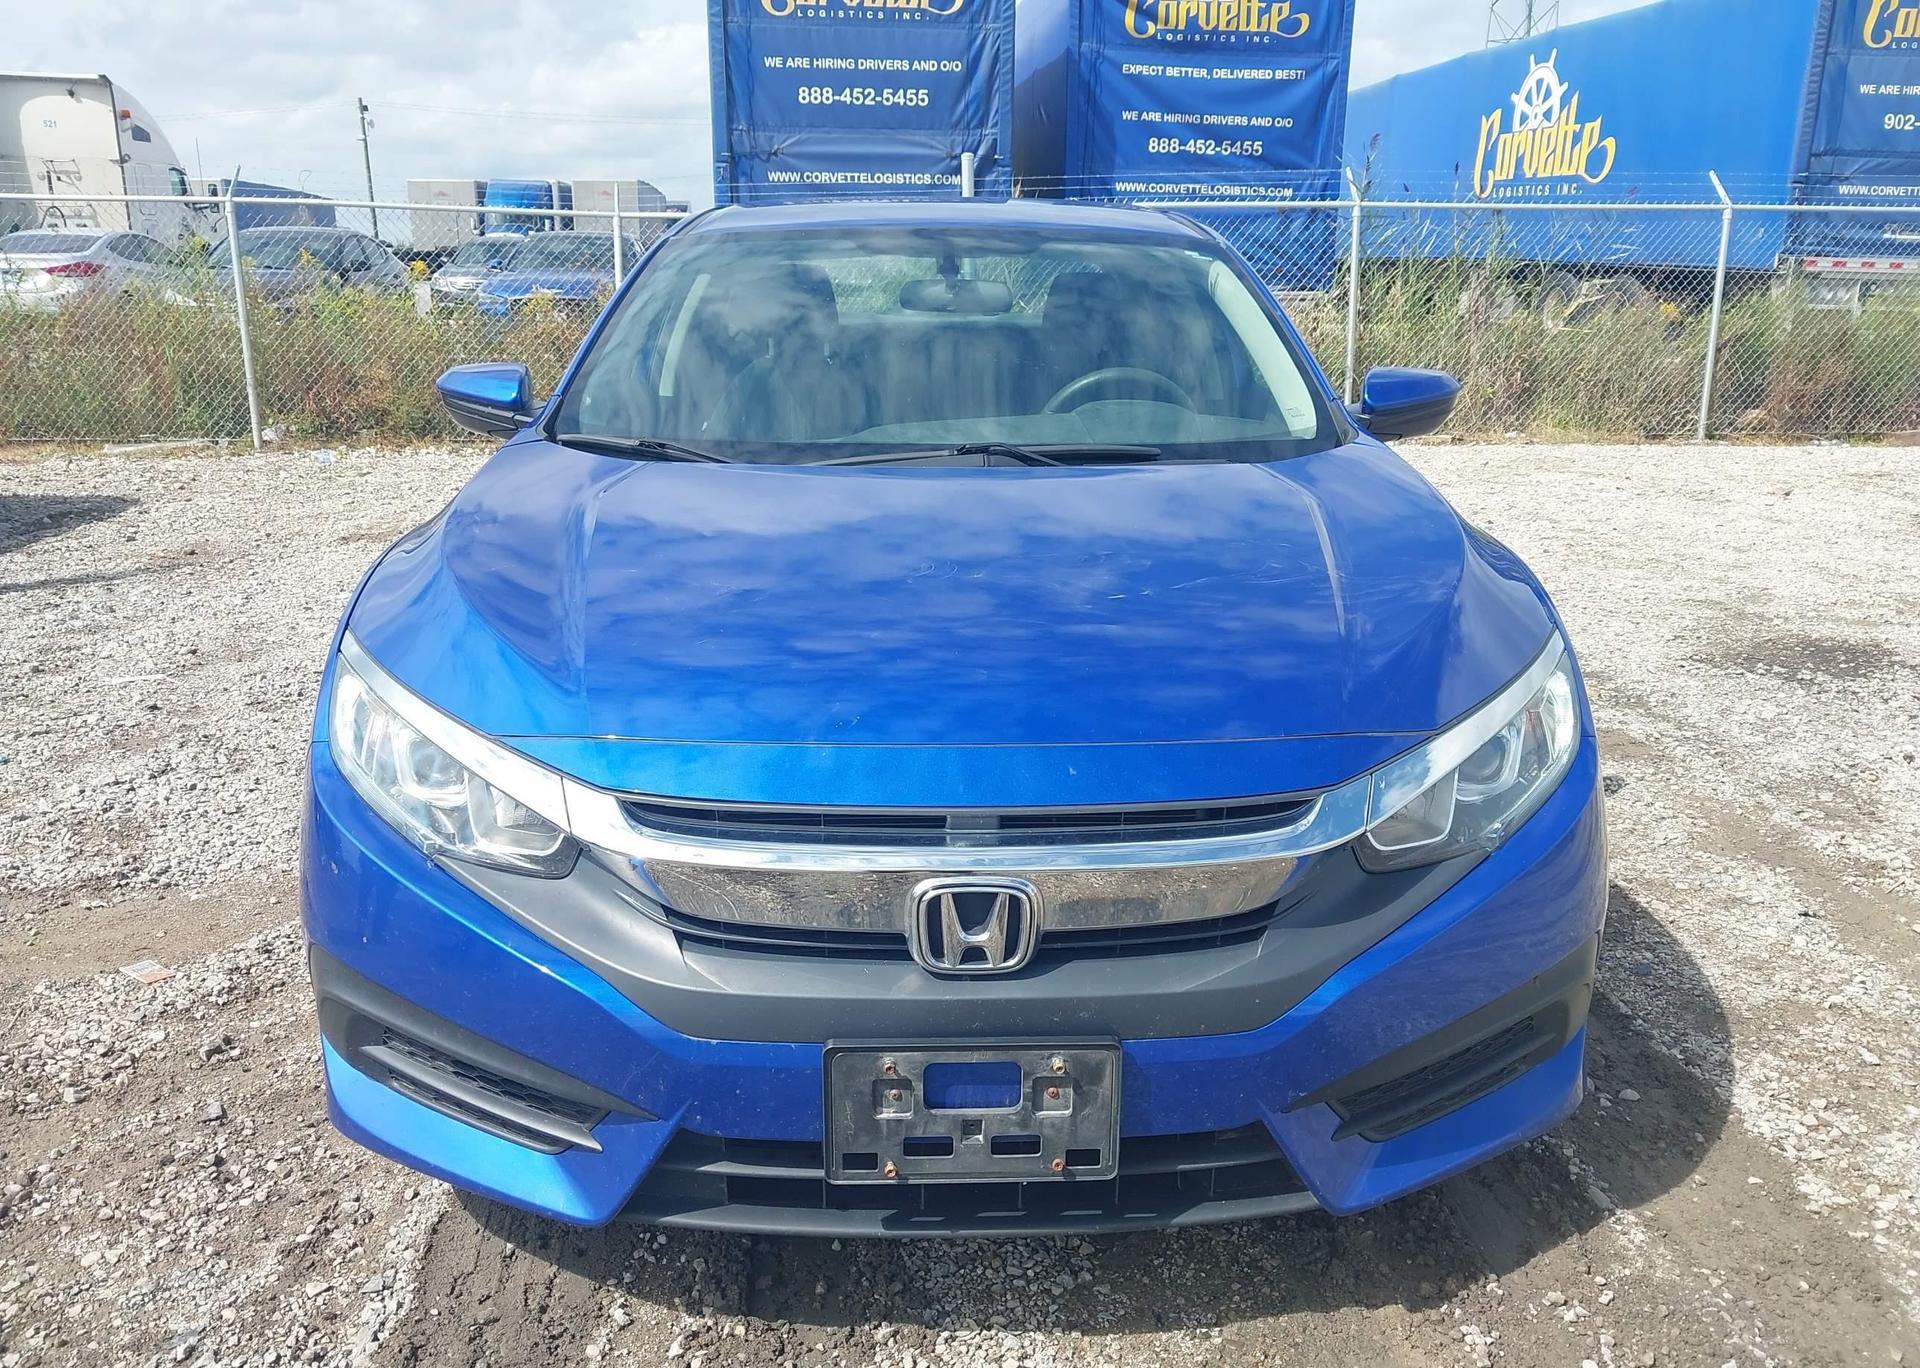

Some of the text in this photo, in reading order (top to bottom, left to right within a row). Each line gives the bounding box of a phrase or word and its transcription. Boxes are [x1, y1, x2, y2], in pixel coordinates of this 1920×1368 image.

[797, 8, 885, 19] LOGISTICS
[895, 12, 930, 20] INC.
[1157, 32, 1278, 43] LOGISTICS INC.
[764, 56, 962, 72] WE ARE HIRING DRIVERS AND O/O
[1122, 63, 1306, 80] EXPECT BETTER, DELIVERED BEST!
[798, 86, 929, 107] 888-452-5455
[1860, 84, 1877, 94] WE
[1878, 84, 1901, 95] ARE
[43, 119, 57, 128] 521
[1122, 110, 1293, 128] WE ARE HIRING DRIVERS AND O/O
[1883, 113, 1920, 130] 902-
[1148, 137, 1263, 156] 888-452-5455
[1473, 89, 1616, 199] Corvette
[767, 171, 961, 186] WWW.CORVETTELOGISTICS.COM
[1115, 181, 1293, 197] WWW.CORVETTELOGISTICS.COM
[1493, 182, 1583, 198] LOGISTICS INC.
[1839, 185, 1920, 197] WWW.CORVETT
